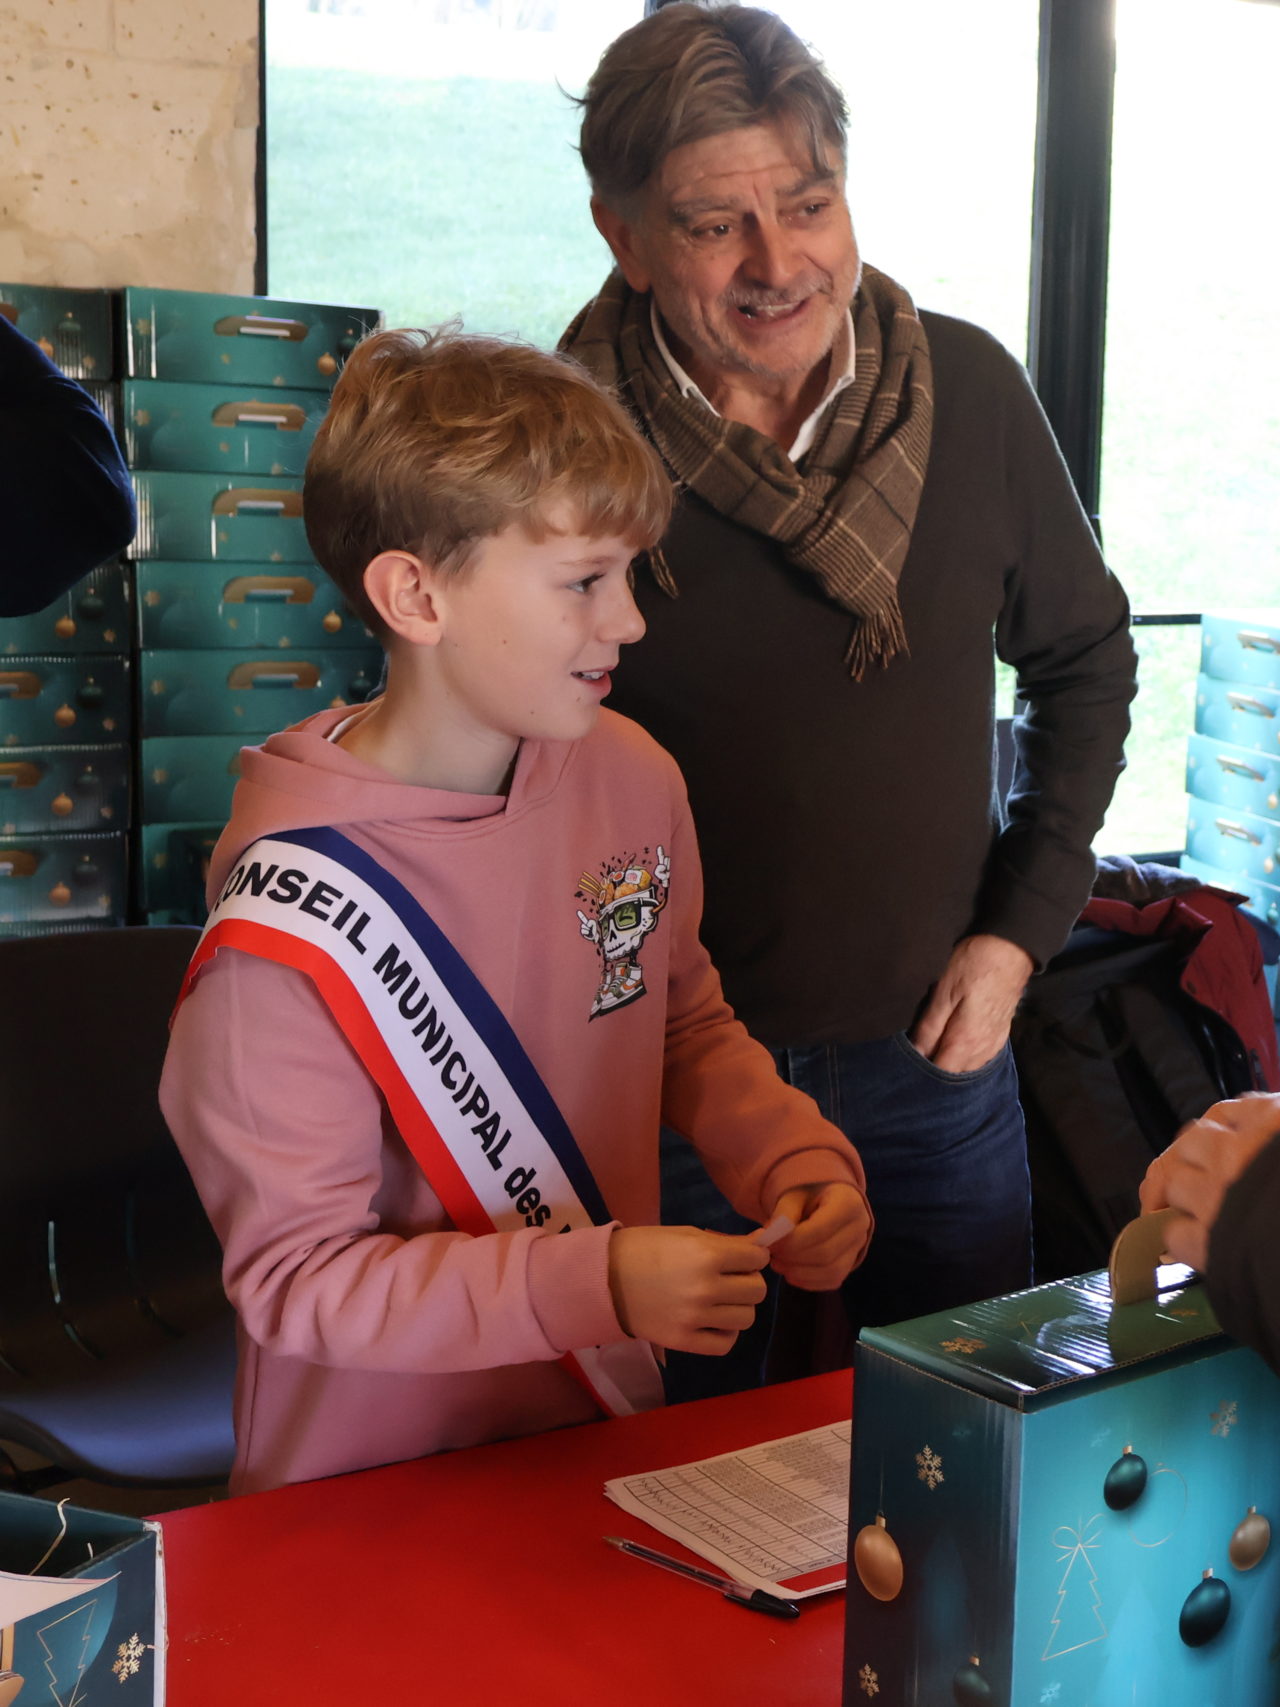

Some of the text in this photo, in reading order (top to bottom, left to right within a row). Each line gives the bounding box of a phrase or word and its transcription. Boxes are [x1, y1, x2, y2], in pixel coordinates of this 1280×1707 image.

[214, 861, 552, 1228] ONSEIL MUNICIPAL des
